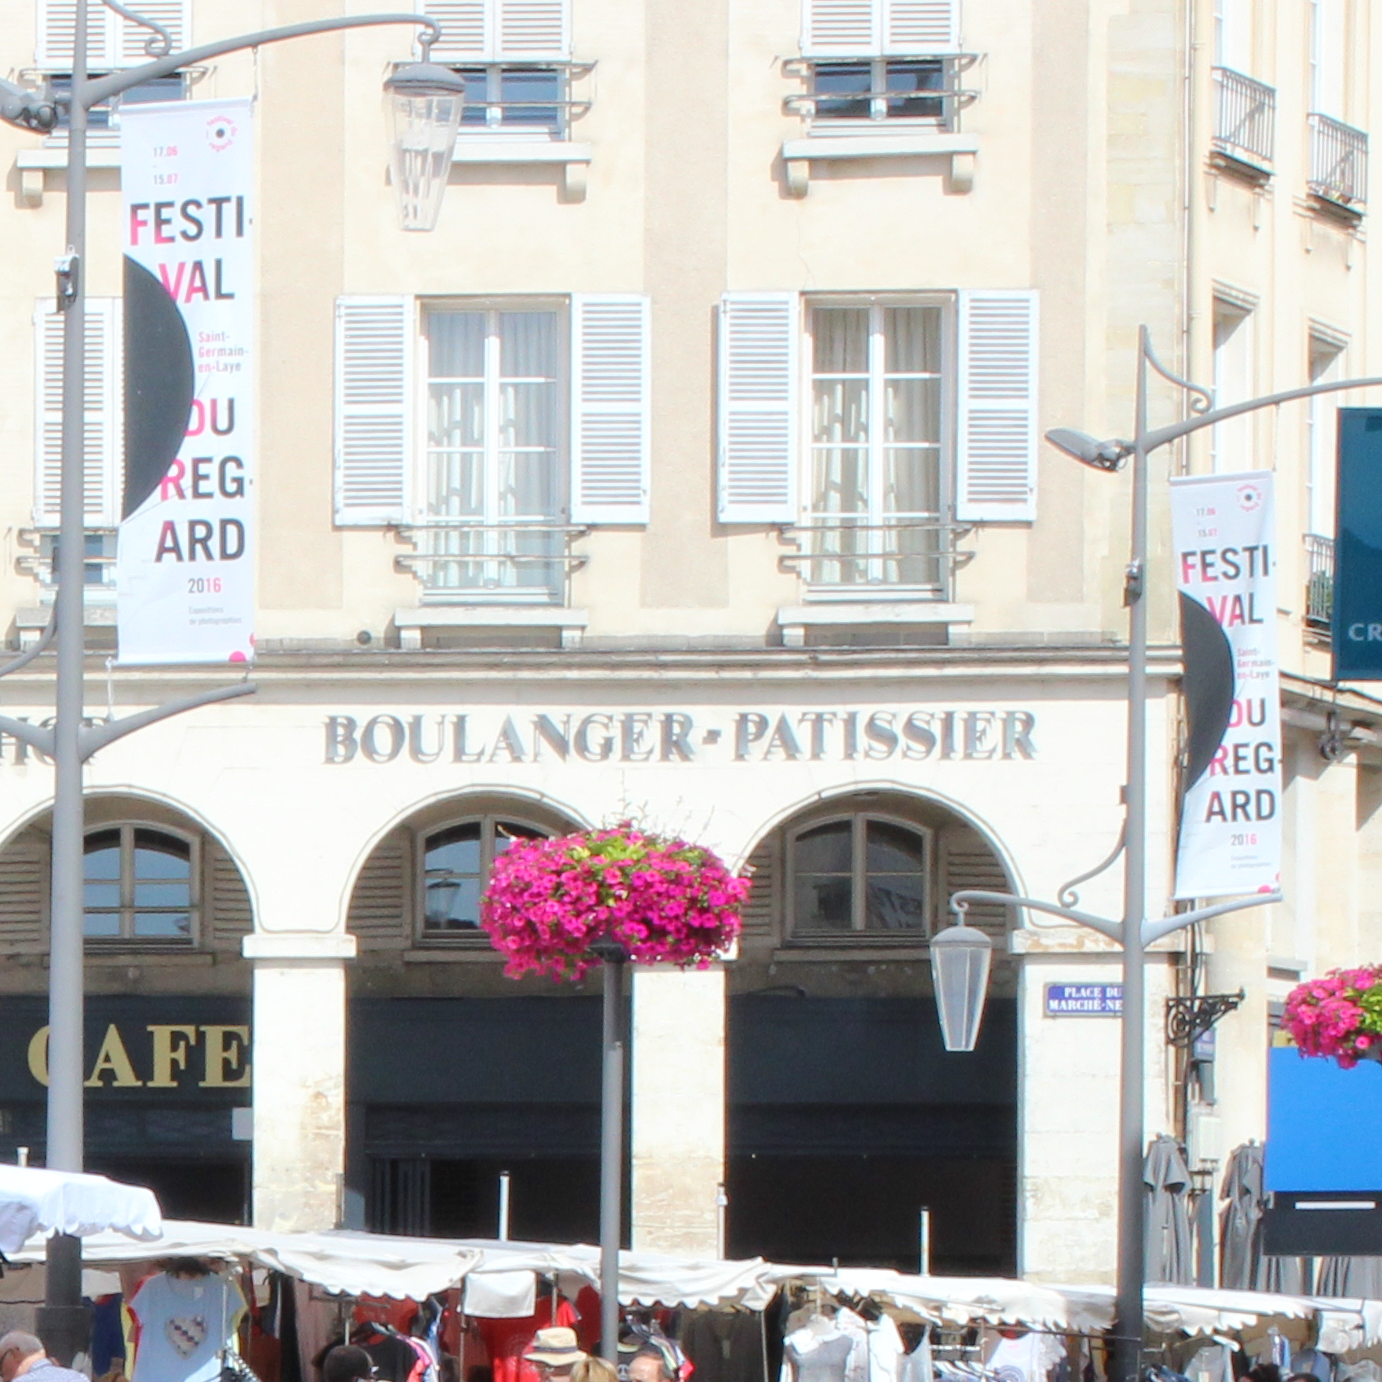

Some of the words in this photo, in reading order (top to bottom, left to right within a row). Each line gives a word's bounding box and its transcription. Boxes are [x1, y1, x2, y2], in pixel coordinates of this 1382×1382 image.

[158, 258, 235, 303] VAL
[198, 331, 230, 343] Saint-
[198, 345, 249, 359] Germain-
[154, 518, 245, 563] ARD
[188, 577, 222, 594] 2016
[1206, 592, 1264, 628] VAL
[1204, 789, 1275, 824] ARD
[1231, 834, 1257, 846] 2016
[1064, 986, 1102, 998] PLACE
[1105, 987, 1123, 998] DU
